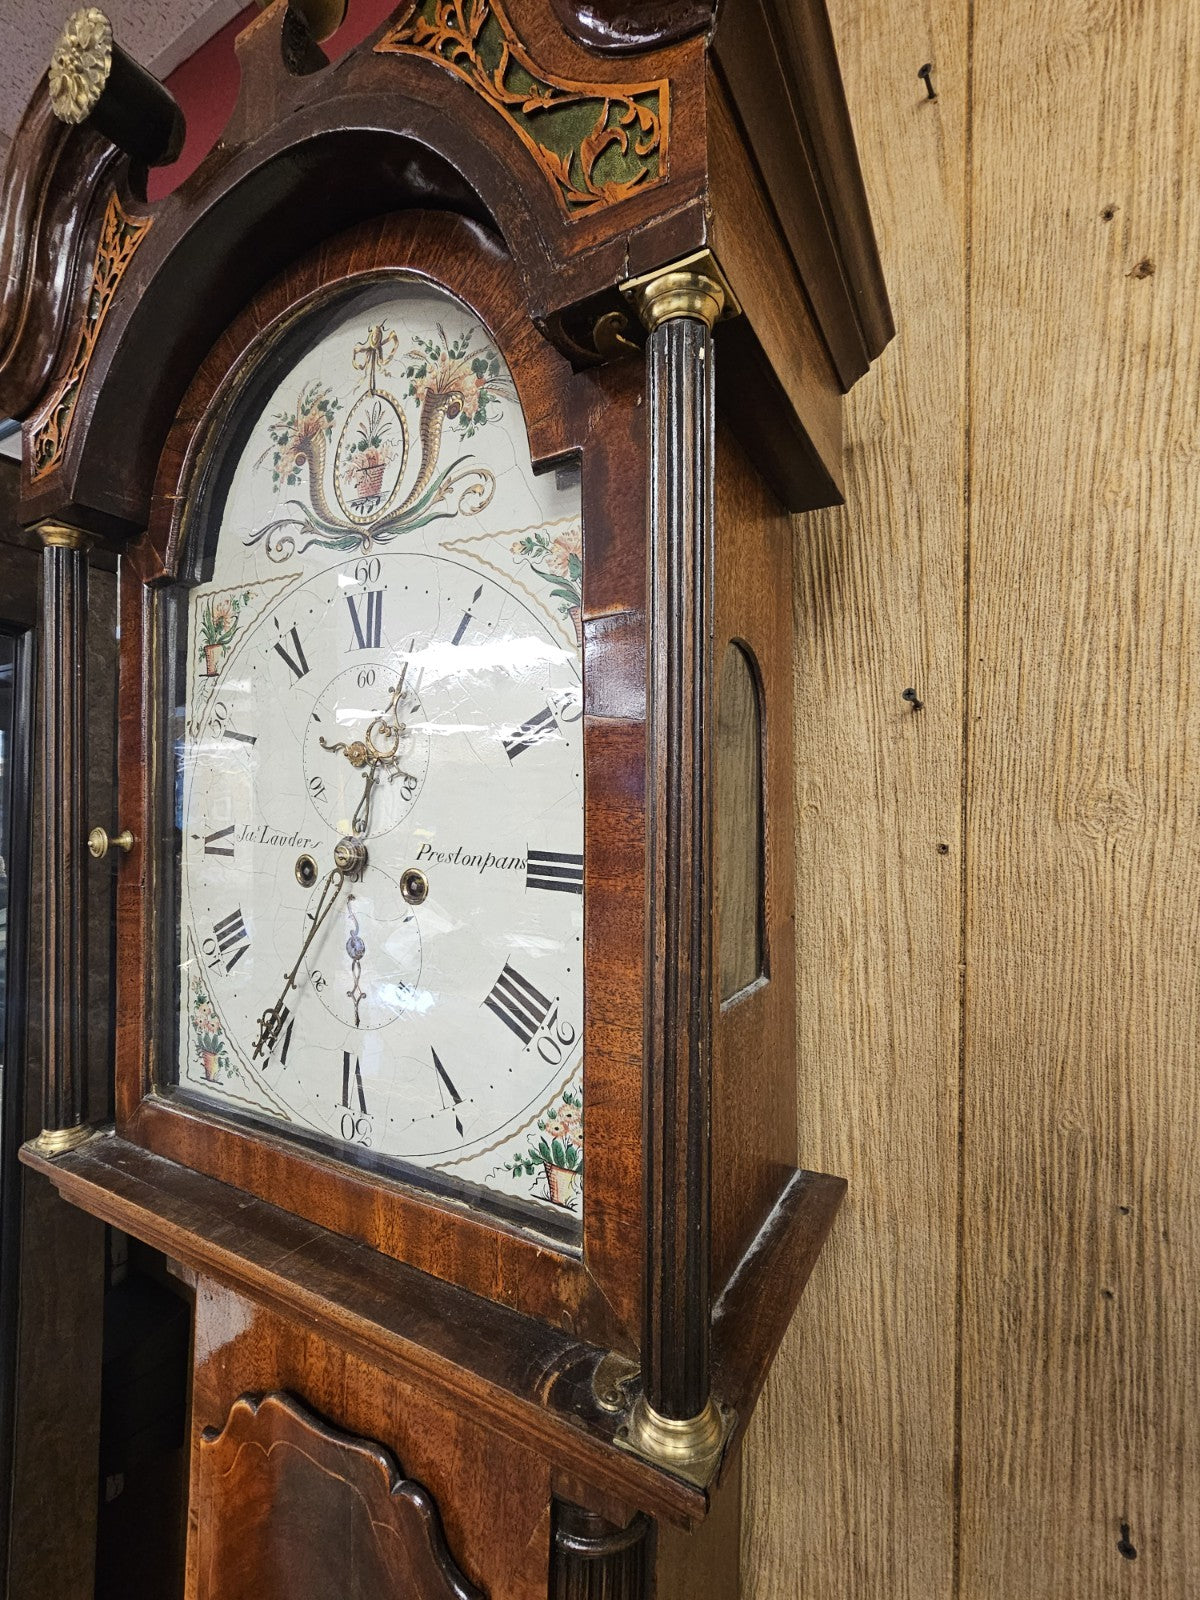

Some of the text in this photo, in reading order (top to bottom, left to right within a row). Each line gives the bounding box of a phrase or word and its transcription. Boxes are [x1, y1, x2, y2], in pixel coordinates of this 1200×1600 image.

[354, 557, 381, 586] 60
[357, 670, 376, 689] 60
[416, 843, 527, 874] Prestonpans
